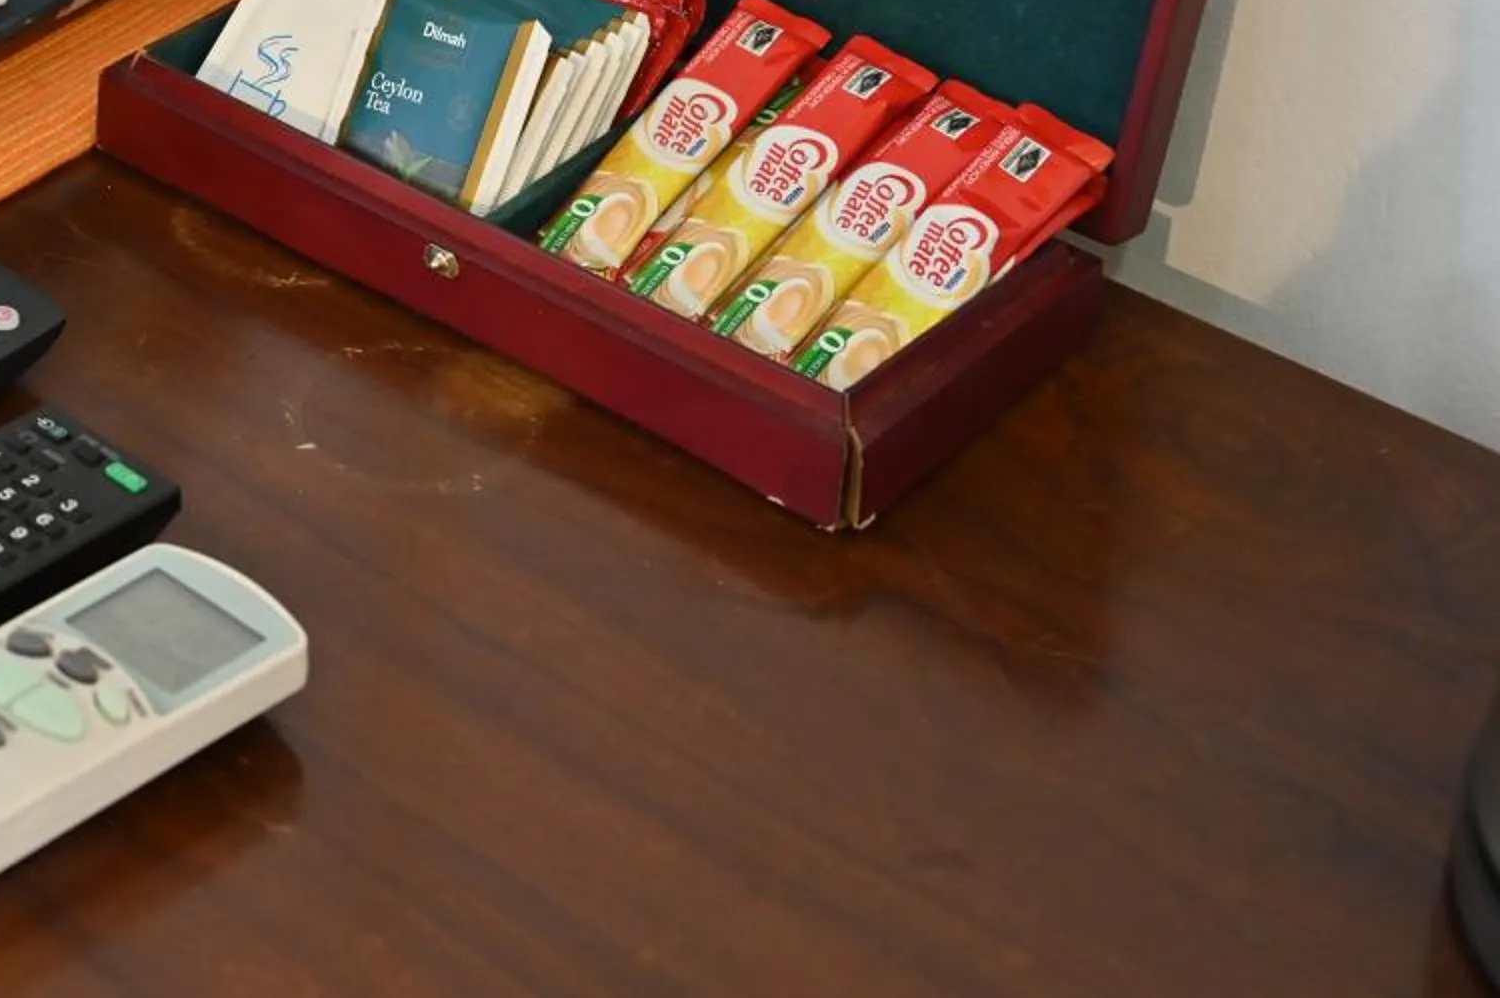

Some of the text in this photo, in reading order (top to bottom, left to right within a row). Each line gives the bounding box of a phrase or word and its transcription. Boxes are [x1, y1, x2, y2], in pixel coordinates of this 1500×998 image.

[422, 20, 468, 51] Dilmah
[364, 89, 392, 116] Tea
[370, 71, 424, 104] Ceylon
[653, 94, 688, 150] mate
[670, 93, 729, 156] Coffee
[749, 141, 788, 196] mate
[766, 137, 829, 203] Coffee
[835, 179, 874, 230] mate
[853, 173, 917, 239] Coffee
[908, 220, 946, 277] mate
[927, 216, 990, 289] Coffee
[20, 473, 42, 488] 2
[59, 497, 80, 513] 3
[9, 525, 30, 541] 9
[35, 512, 55, 527] 6
